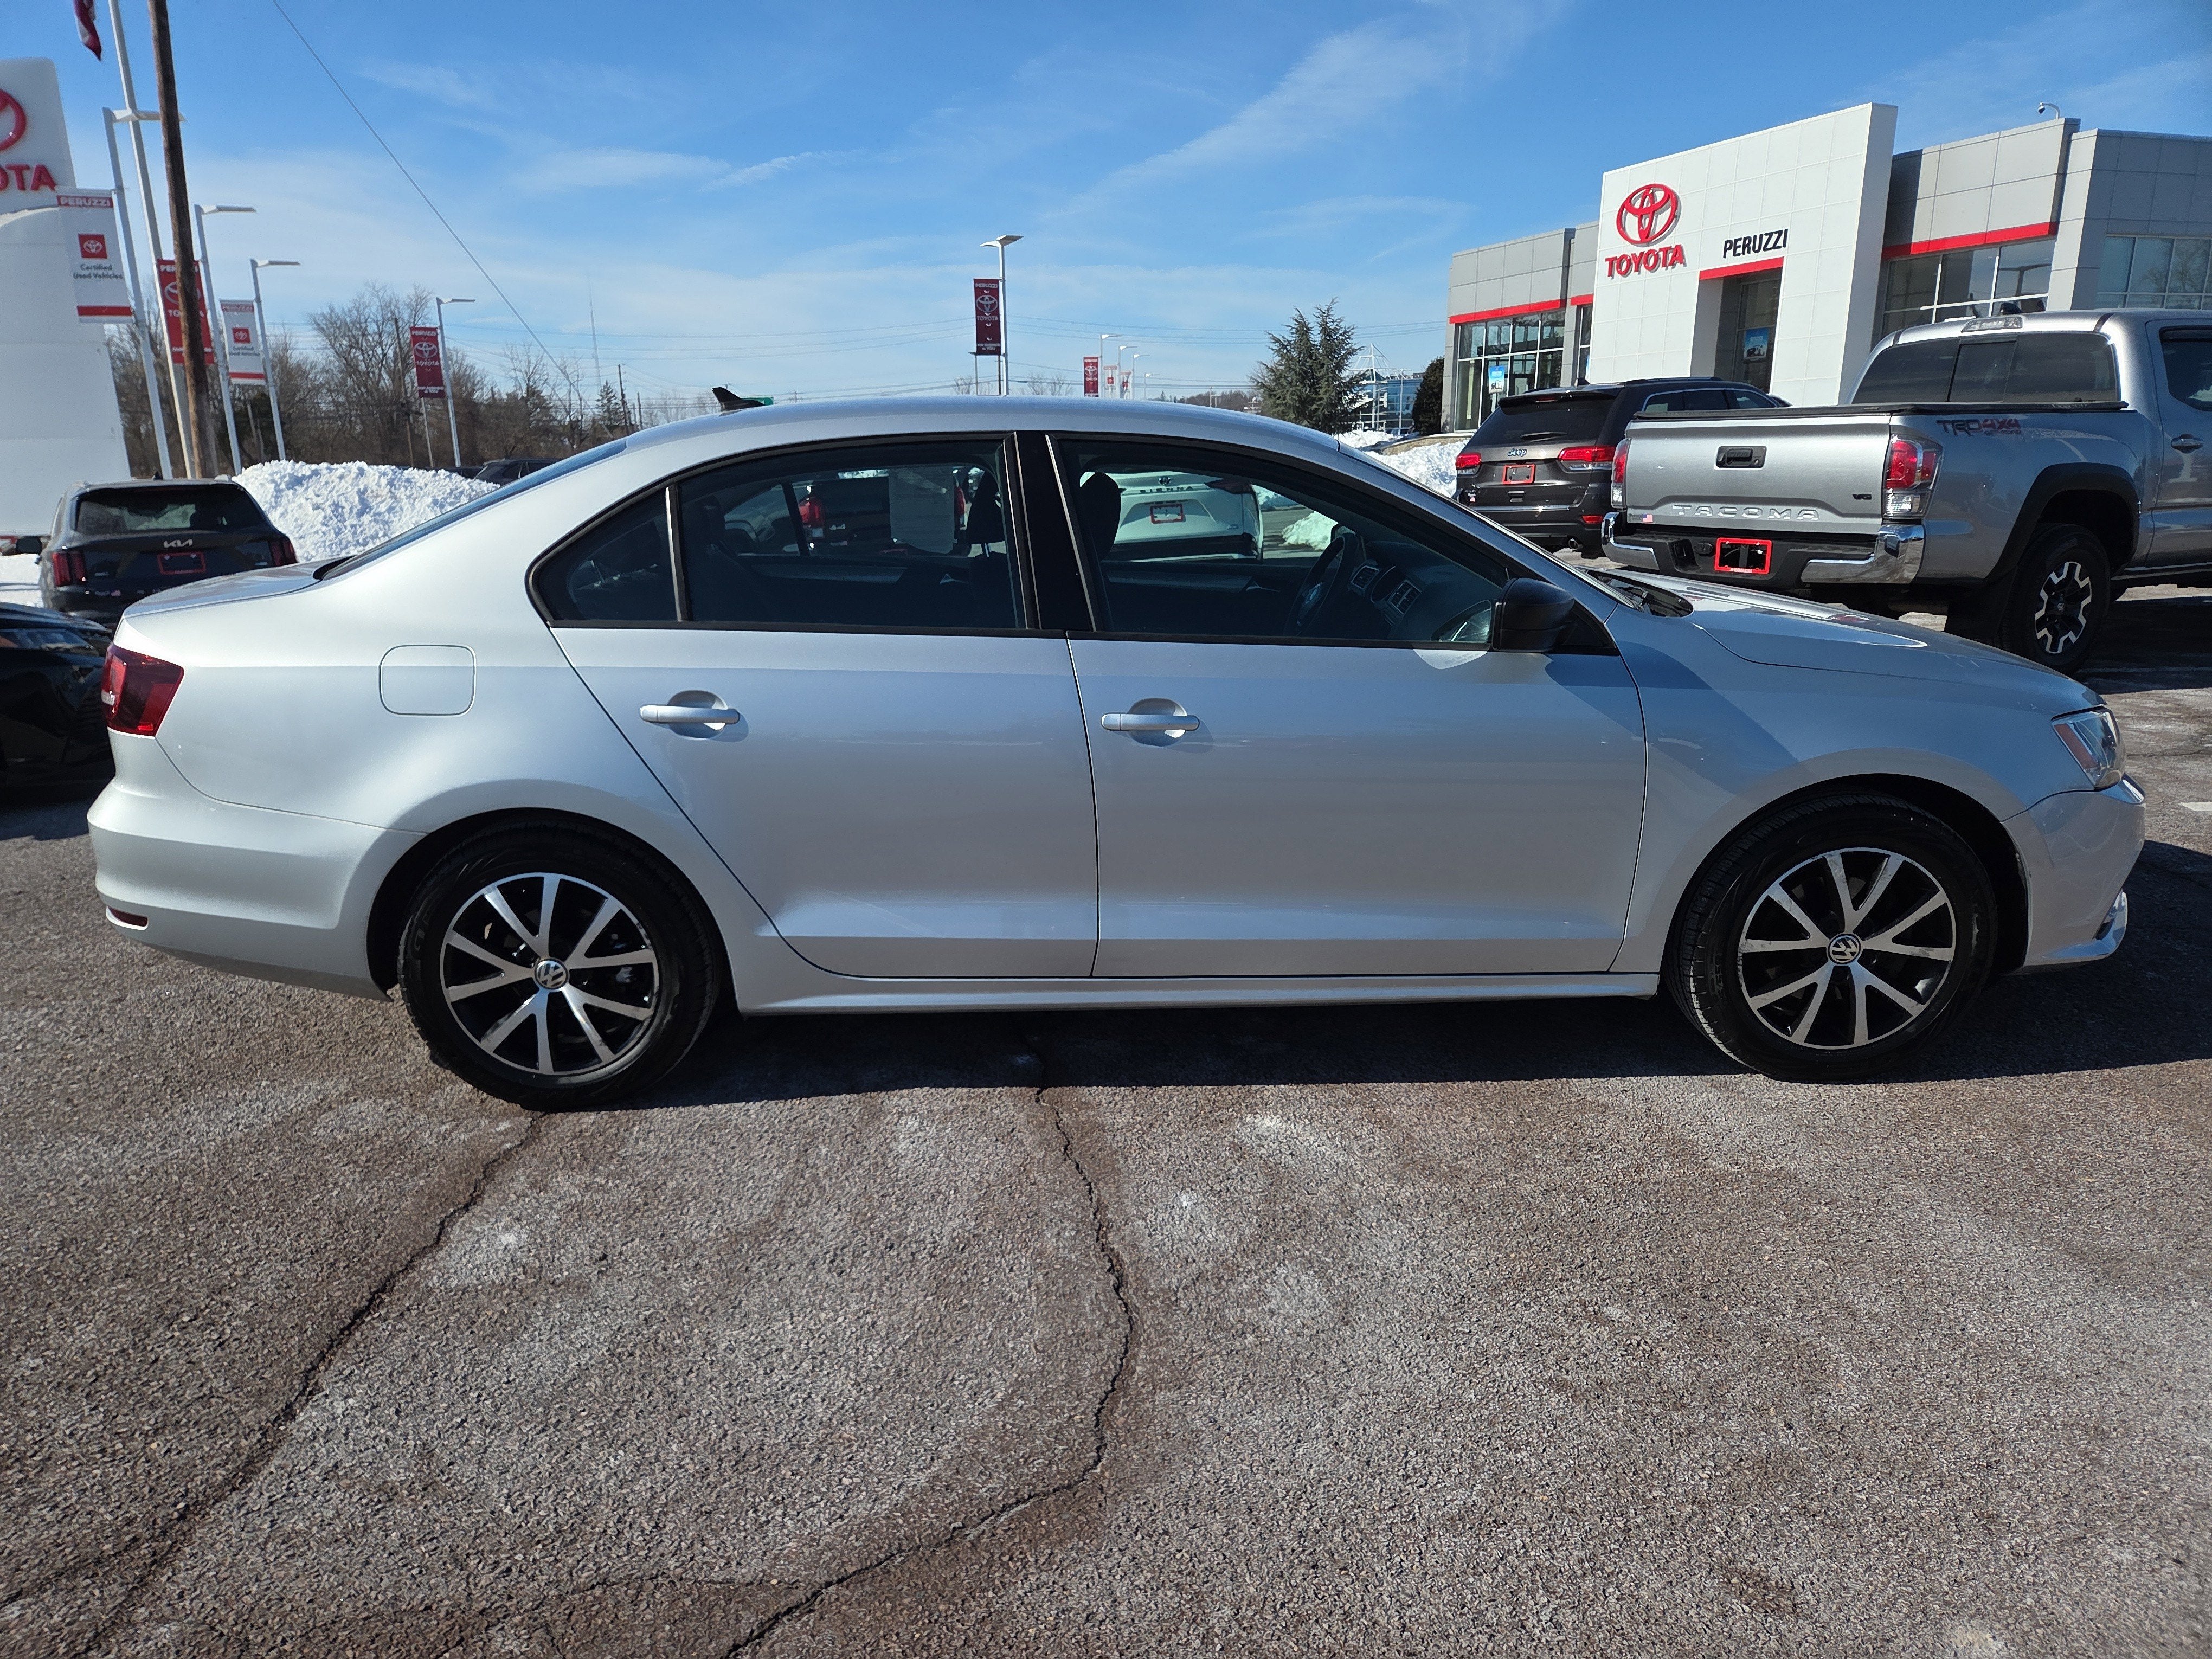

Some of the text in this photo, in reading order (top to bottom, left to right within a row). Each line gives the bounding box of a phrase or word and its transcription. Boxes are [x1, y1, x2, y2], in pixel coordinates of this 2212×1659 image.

[60, 197, 111, 207] PERUZZI
[1723, 229, 1789, 259] PERUZZI
[1605, 244, 1686, 278] TOYOTA
[1507, 448, 1527, 457] Jeep
[1672, 504, 1820, 520] TACOMA
